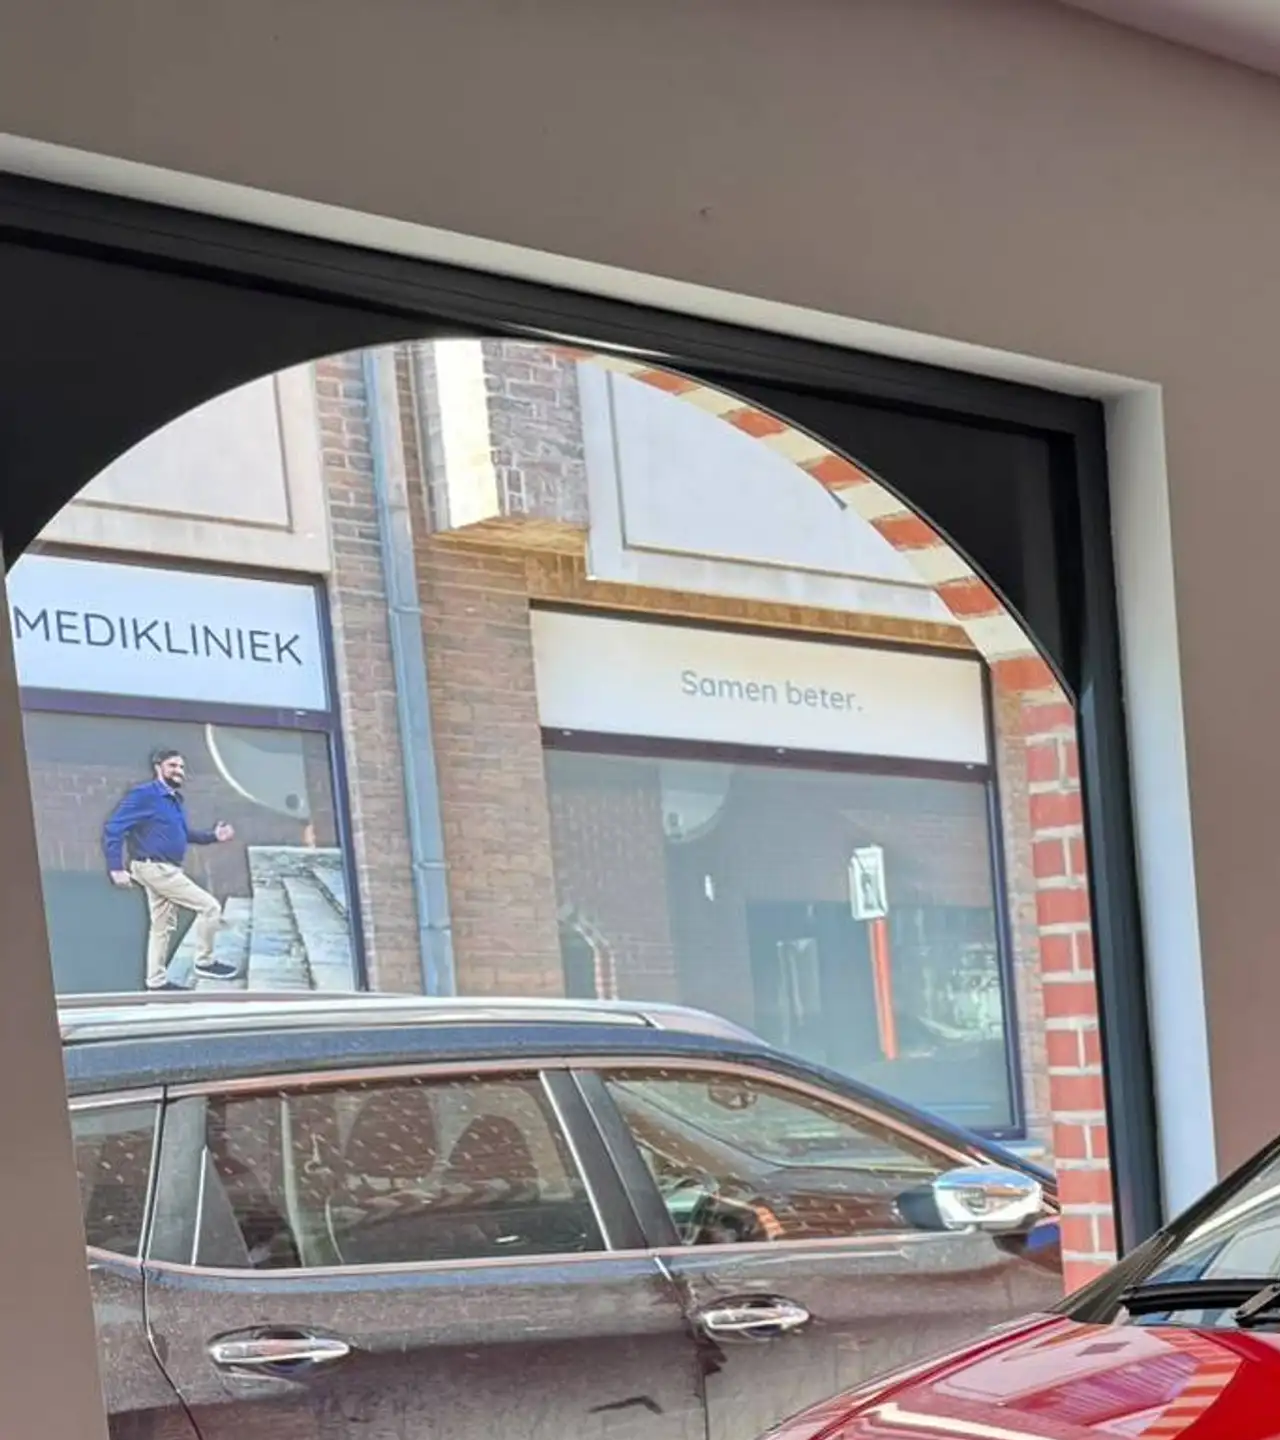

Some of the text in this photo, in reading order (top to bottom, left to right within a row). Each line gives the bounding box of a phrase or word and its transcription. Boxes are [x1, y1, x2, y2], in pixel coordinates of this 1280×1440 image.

[12, 605, 303, 665] MEDIKLINIEK
[681, 669, 864, 712] Samen beter.
